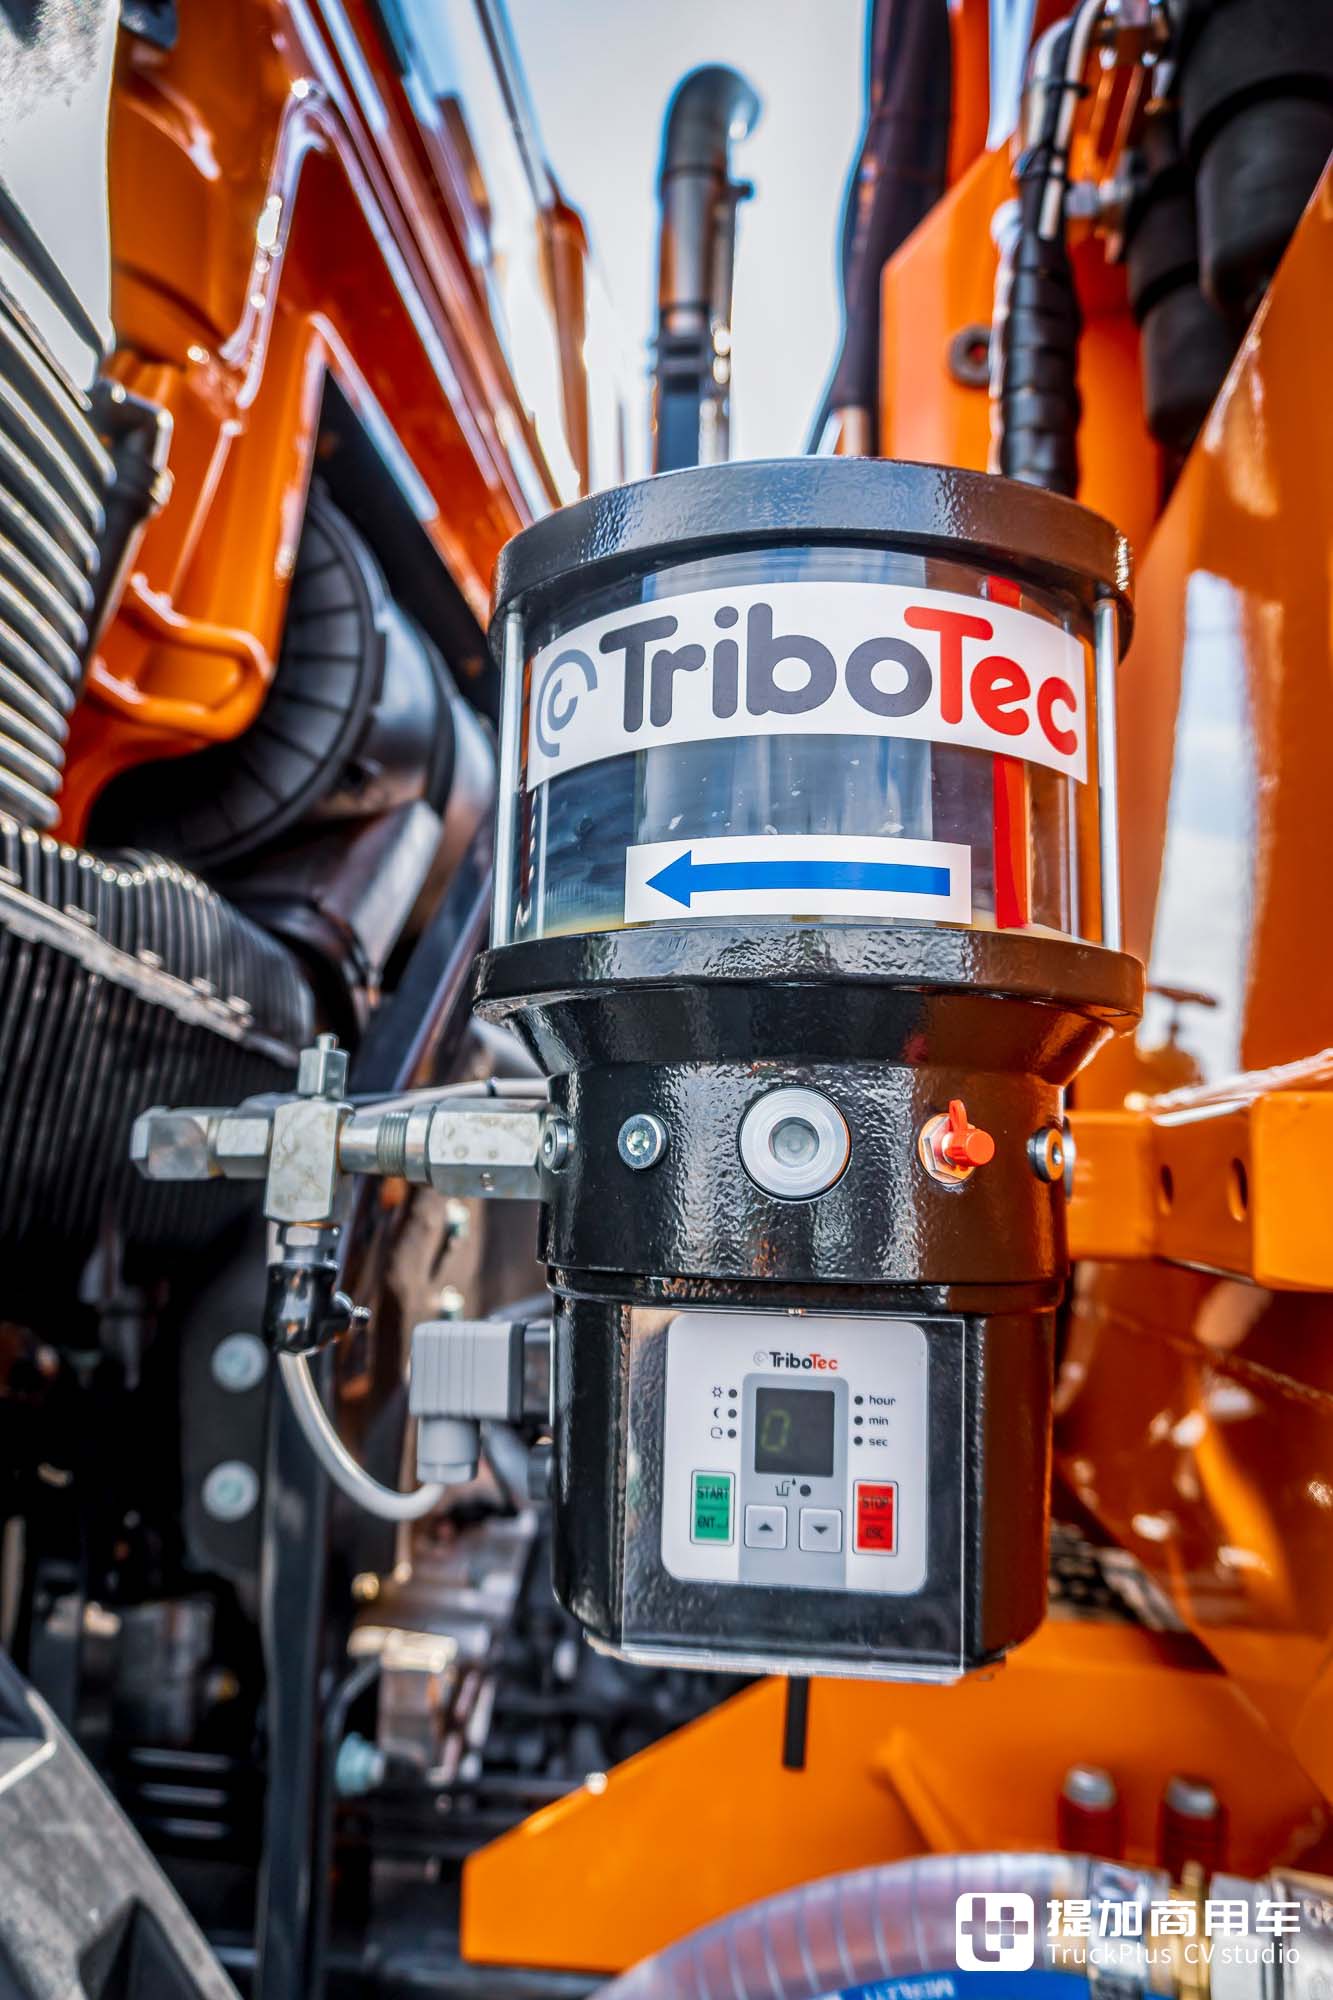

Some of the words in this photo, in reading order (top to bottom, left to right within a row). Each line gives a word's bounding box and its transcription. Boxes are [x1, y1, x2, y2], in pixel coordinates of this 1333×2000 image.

[599, 602, 1079, 756] TriboTec
[769, 1351, 838, 1370] TriboTec
[869, 1395, 896, 1406] hour
[868, 1416, 889, 1426] min
[868, 1438, 889, 1447] sec
[696, 1486, 729, 1500] START
[862, 1496, 889, 1509] STOP
[697, 1516, 715, 1529] ENT
